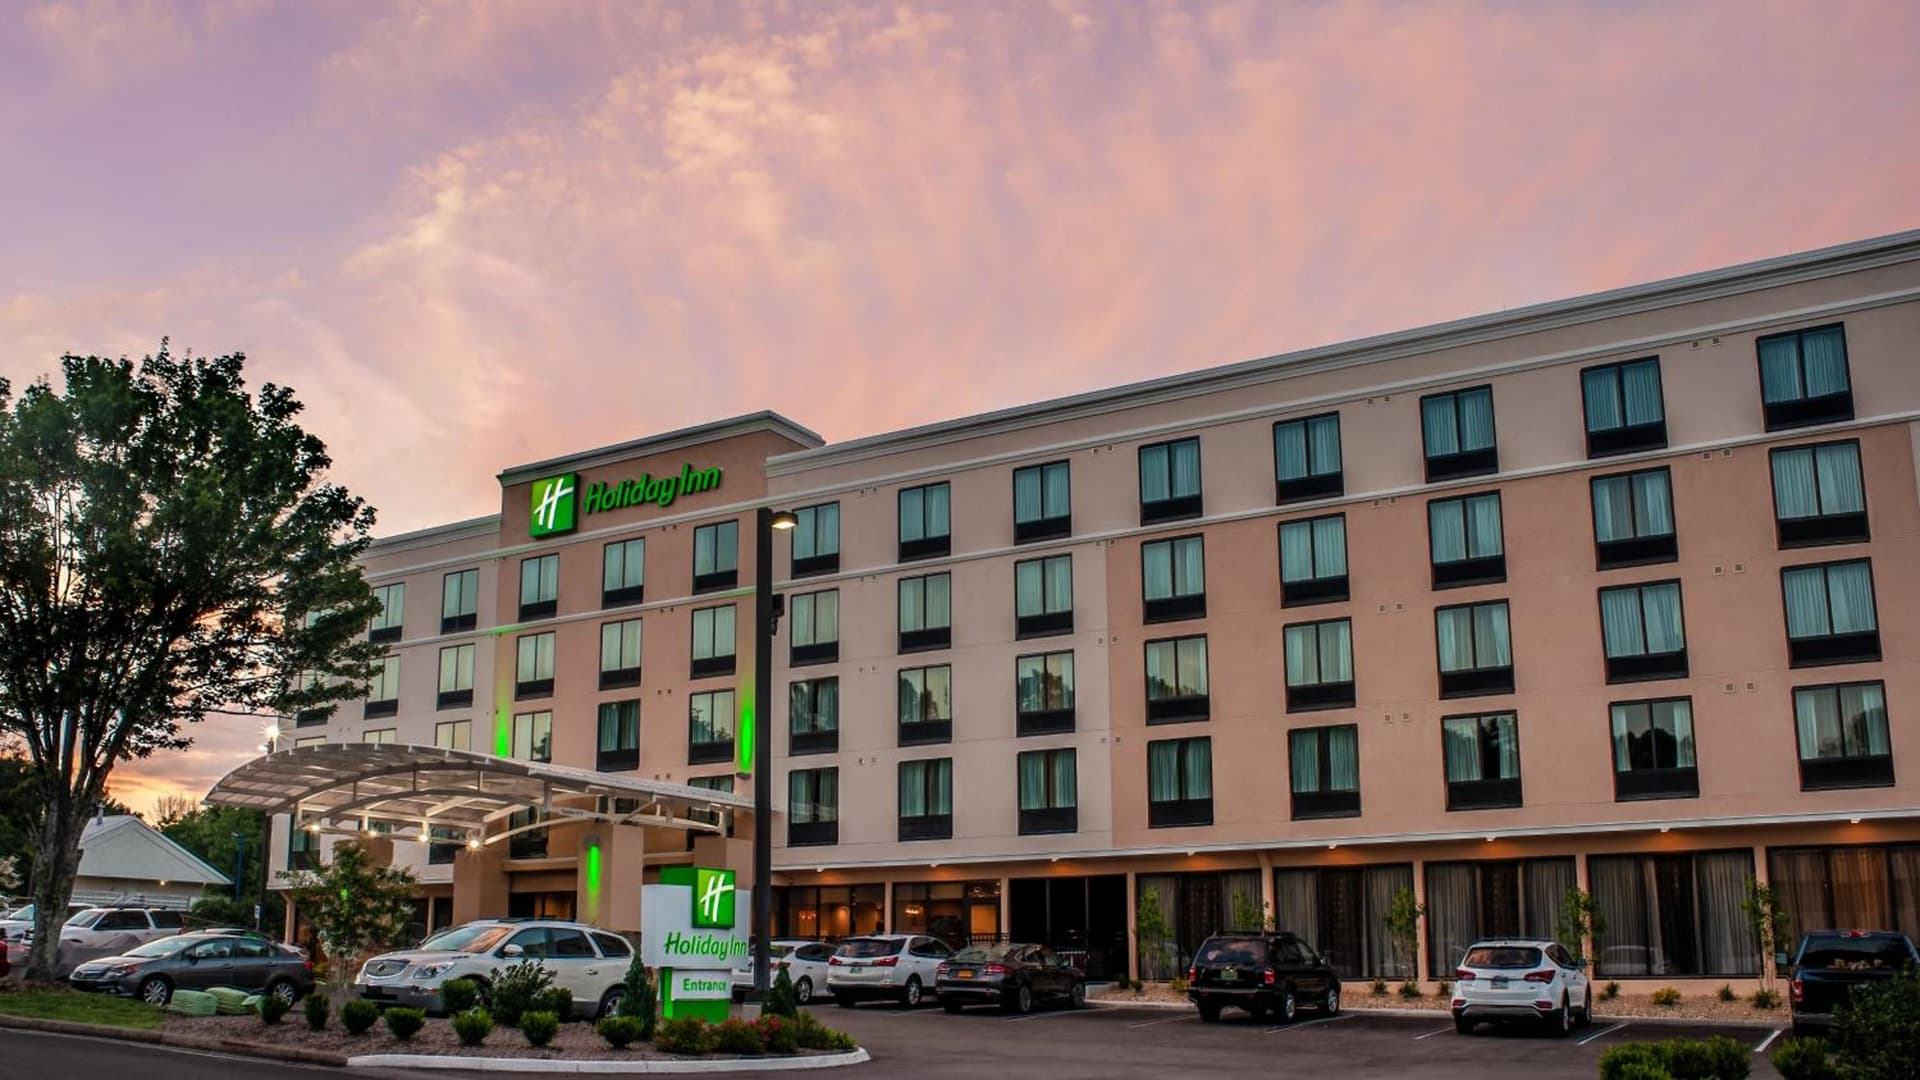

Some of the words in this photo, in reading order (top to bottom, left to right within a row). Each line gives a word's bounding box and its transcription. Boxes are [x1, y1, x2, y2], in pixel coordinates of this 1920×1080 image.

[534, 478, 574, 529] H
[584, 473, 678, 513] Holiday
[679, 463, 721, 497] Inn
[700, 873, 735, 922] H
[664, 931, 729, 961] Holiday
[730, 934, 747, 957] Inn
[683, 978, 727, 992] Entrance
